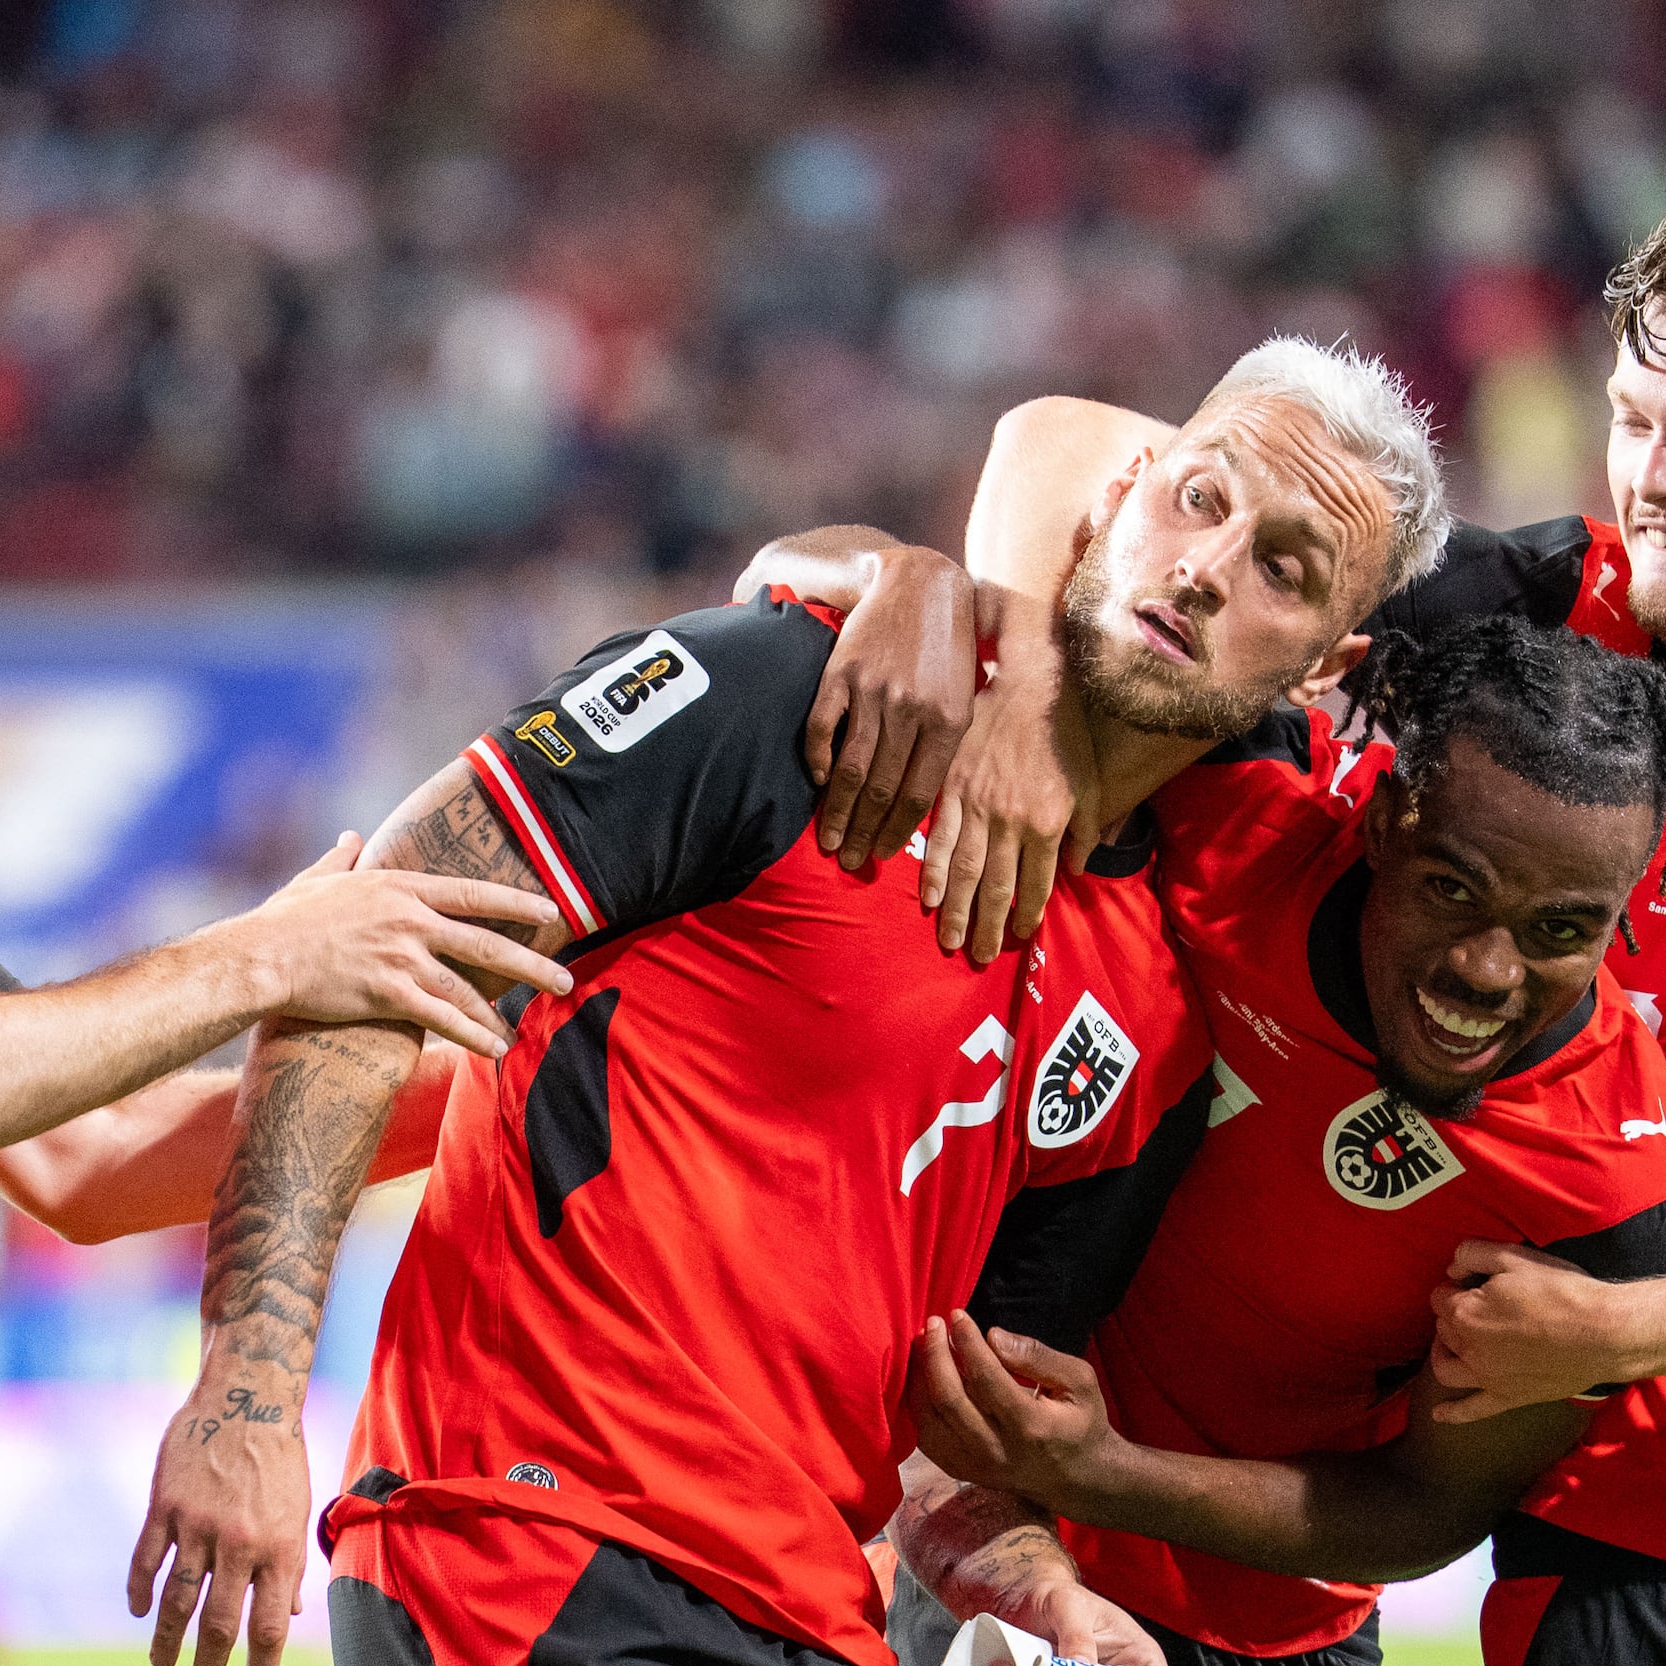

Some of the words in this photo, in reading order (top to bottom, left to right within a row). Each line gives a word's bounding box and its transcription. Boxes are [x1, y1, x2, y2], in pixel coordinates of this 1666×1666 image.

[590, 695, 609, 715] WORLD
[607, 710, 622, 727] CUP
[609, 687, 628, 707] FIFA
[579, 701, 614, 736] 2026
[539, 726, 570, 756] DEBUT
[1093, 1018, 1121, 1054] ÖFB
[899, 1013, 1016, 1198] 7
